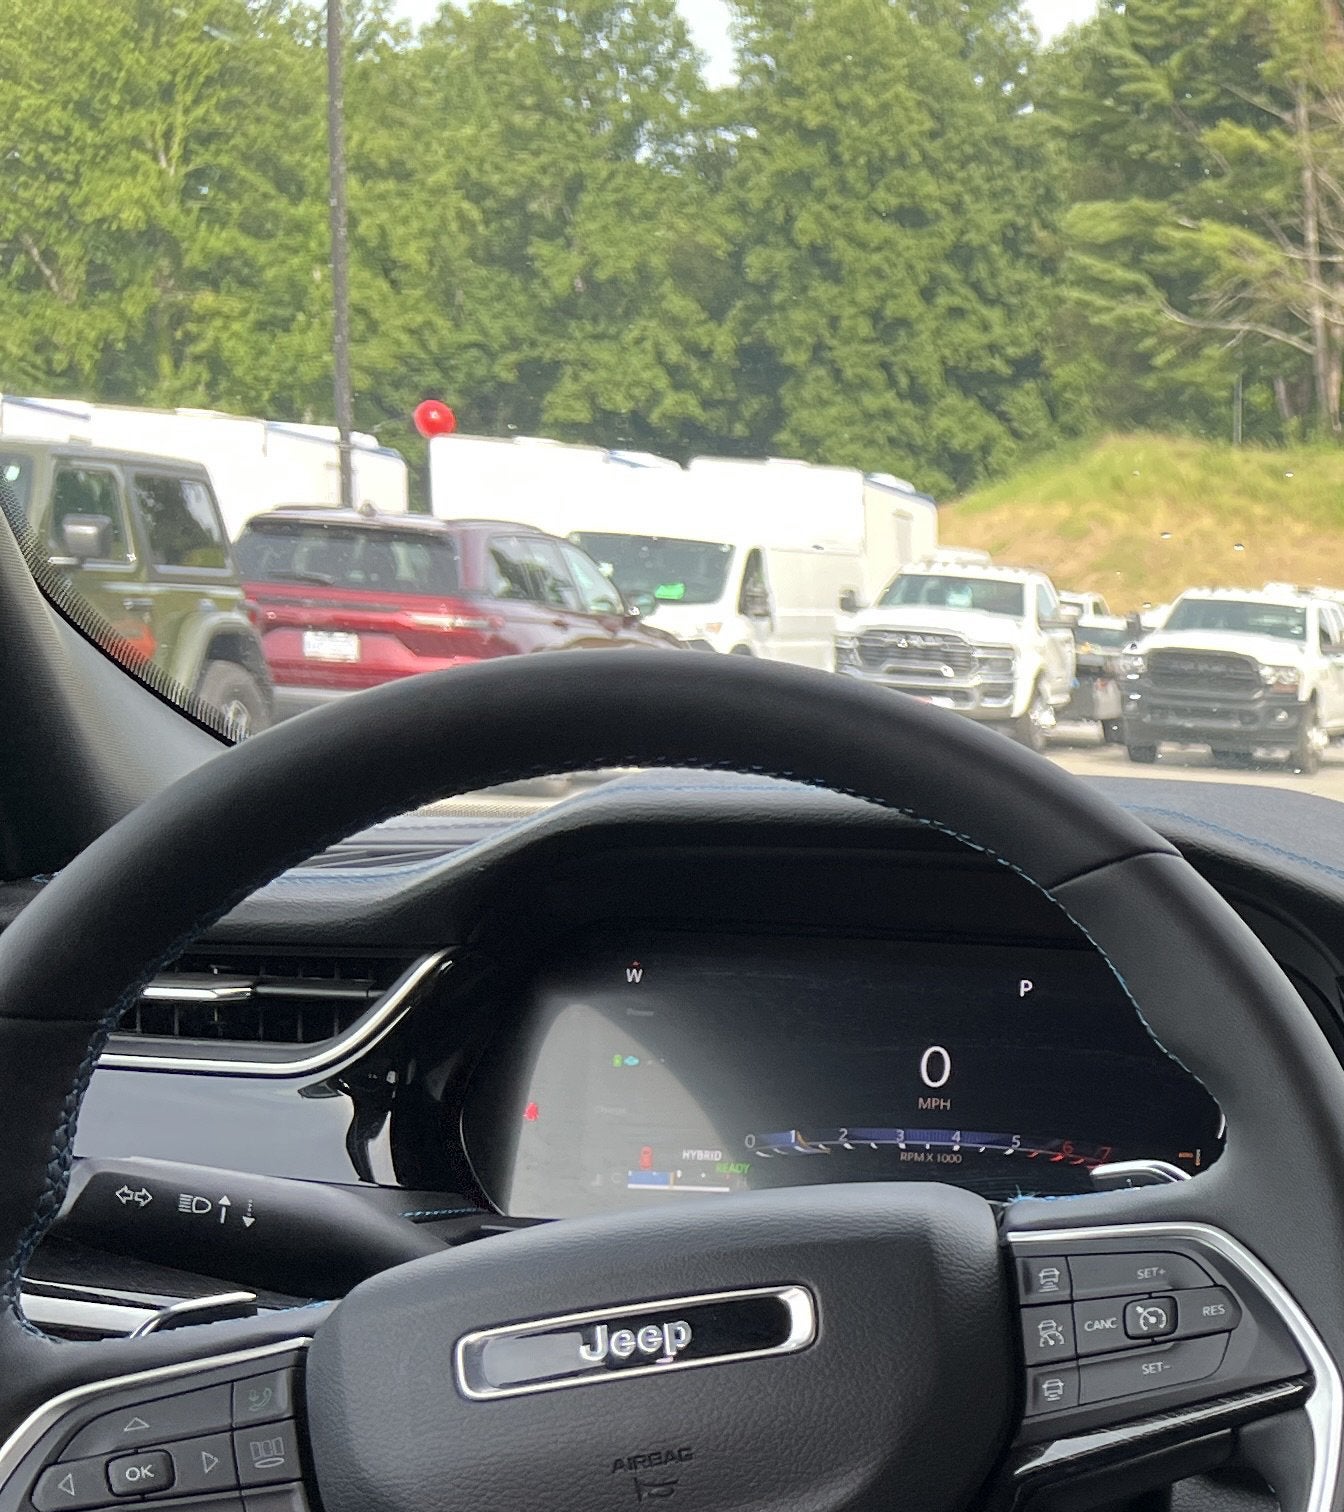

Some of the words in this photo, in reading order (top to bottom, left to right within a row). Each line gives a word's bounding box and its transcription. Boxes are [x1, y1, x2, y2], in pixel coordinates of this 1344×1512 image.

[625, 968, 644, 984] W
[1019, 980, 1033, 997] P
[919, 1045, 952, 1089] 0
[917, 1096, 952, 1112] MPH
[744, 1133, 757, 1149] 0
[838, 1127, 849, 1143] 2
[894, 1128, 906, 1144] 3
[951, 1129, 962, 1144] 4
[1010, 1133, 1022, 1149] 5
[682, 1149, 722, 1162] HYBRID
[900, 1151, 925, 1164] RPM
[937, 1152, 963, 1165] 1000
[714, 1162, 751, 1175] READY
[1202, 1303, 1227, 1317] RES
[1083, 1316, 1120, 1333] CANC
[579, 1320, 693, 1362] Jeep
[611, 1448, 695, 1474] AIRBAG
[124, 1463, 155, 1482] OK
